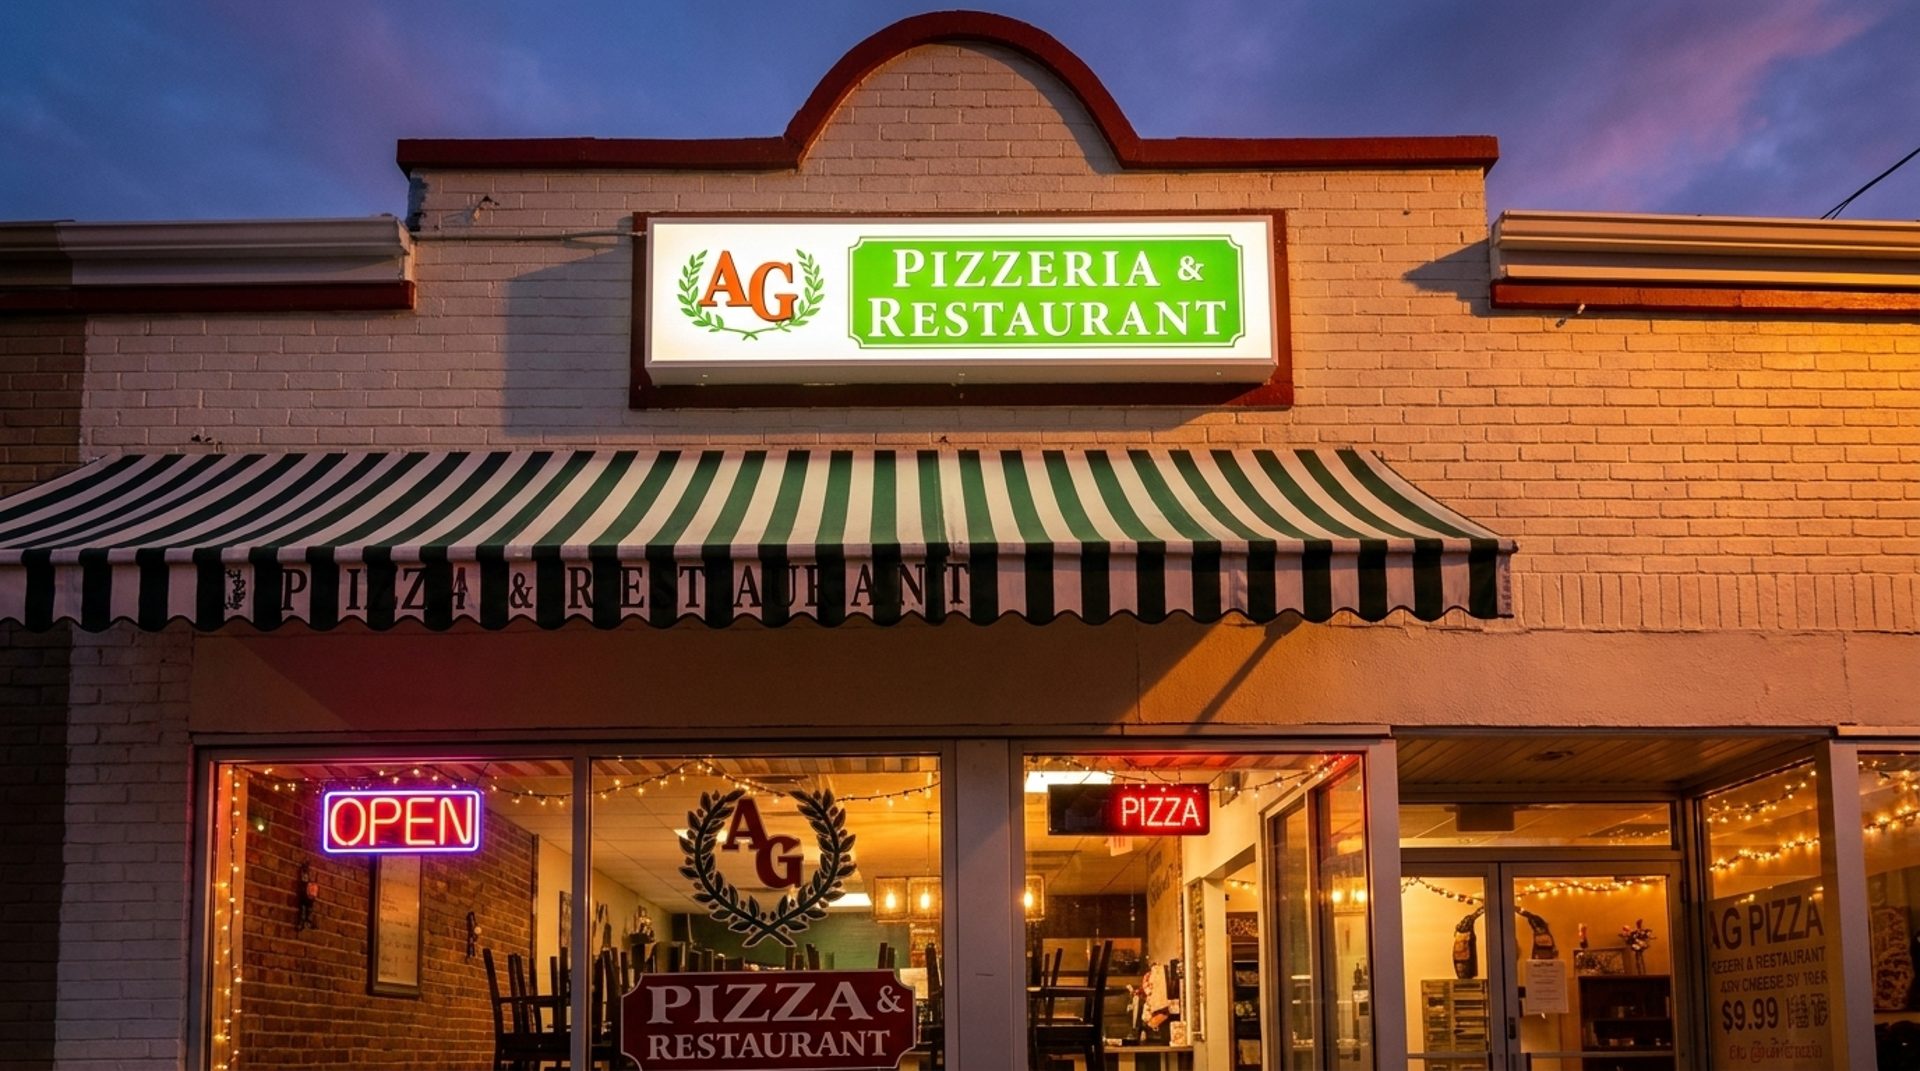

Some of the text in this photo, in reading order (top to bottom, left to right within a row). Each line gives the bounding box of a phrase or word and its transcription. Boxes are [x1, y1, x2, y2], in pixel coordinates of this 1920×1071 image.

[698, 249, 799, 323] AG
[892, 248, 1206, 288] PIZZERIA &
[867, 297, 1227, 338] RESTAURANT
[509, 572, 534, 609] &
[330, 797, 473, 846] OPEN
[1121, 797, 1201, 827] PIZZA
[721, 796, 804, 889] AG
[1749, 896, 1825, 946] PIZZA
[1756, 946, 1827, 970] RESTAURANT
[645, 981, 905, 1025] PIZZA &
[1721, 996, 1779, 1035] $9.99
[647, 1030, 891, 1061] RESTAURANT
